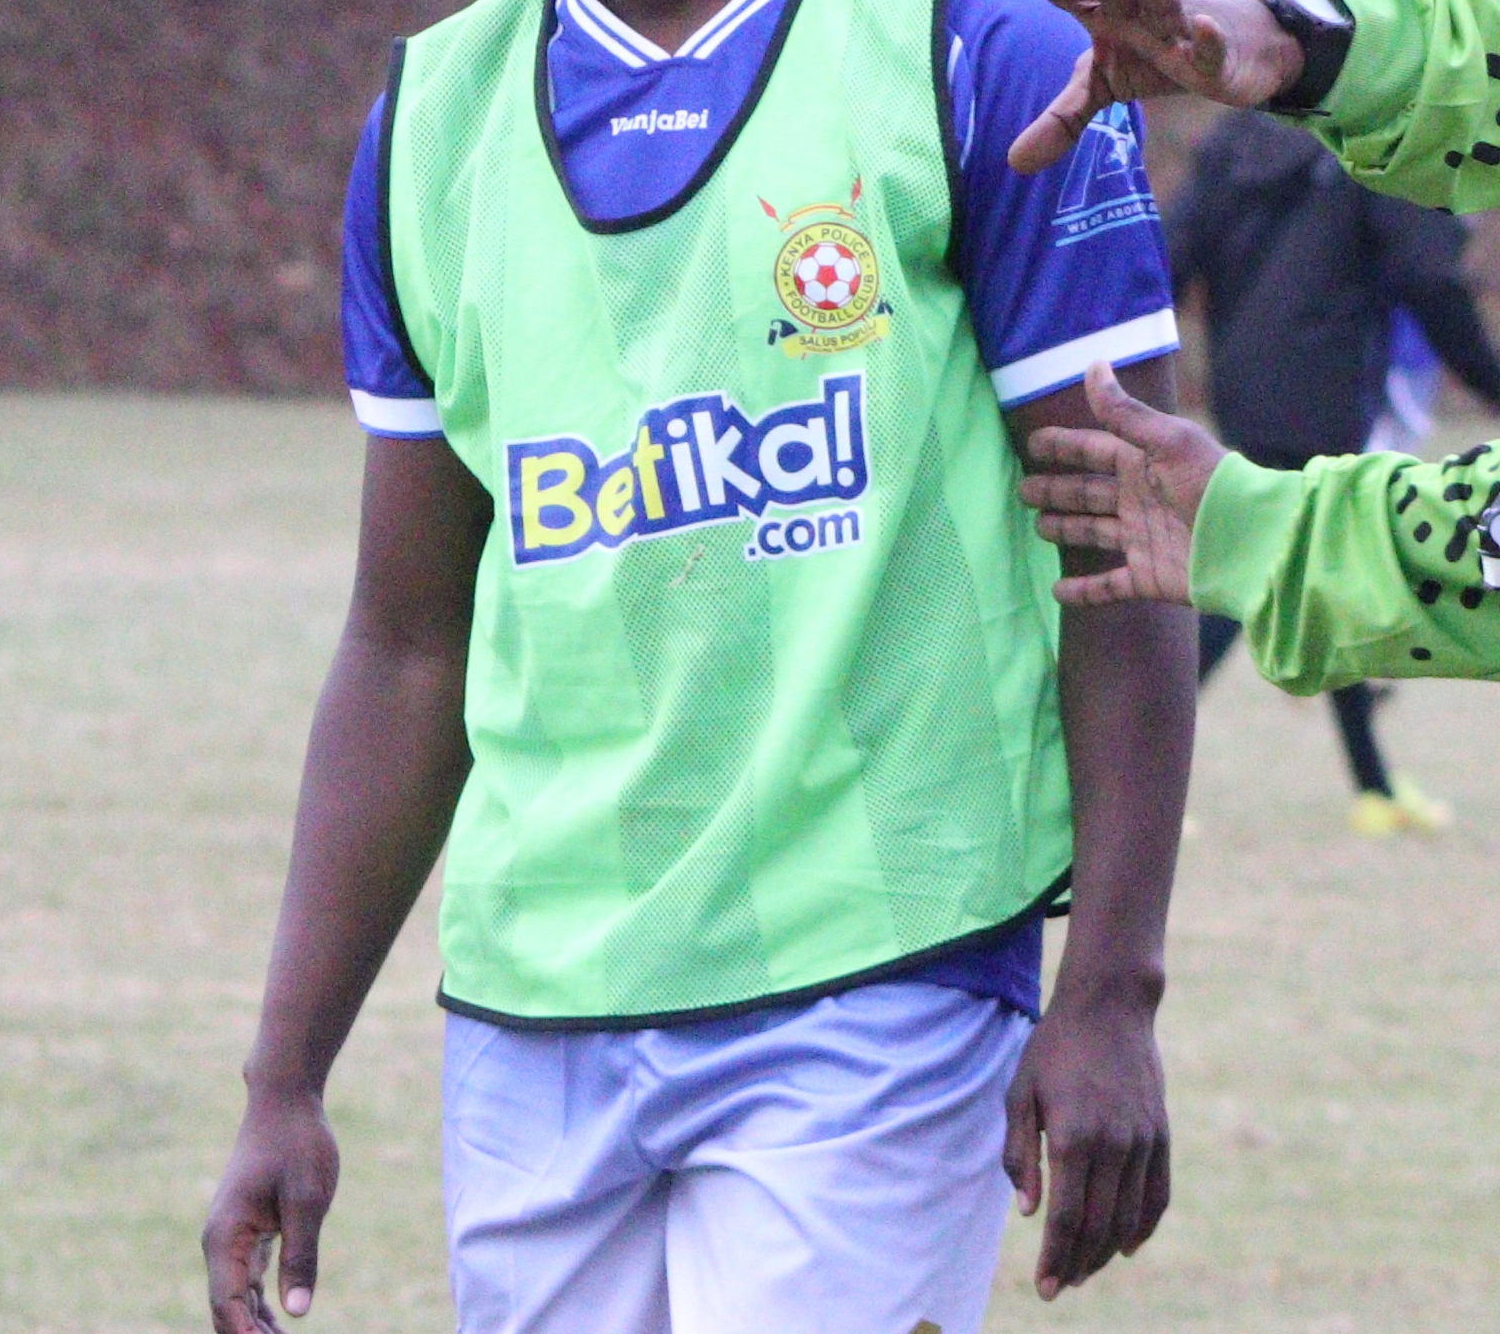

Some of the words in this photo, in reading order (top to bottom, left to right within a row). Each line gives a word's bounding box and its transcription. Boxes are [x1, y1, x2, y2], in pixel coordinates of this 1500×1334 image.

[780, 233, 814, 277] KENYA
[821, 228, 870, 259] POLICE
[786, 290, 855, 324] FOOTBALL
[852, 274, 875, 310] CLUB
[799, 334, 838, 347] SALUS
[518, 388, 858, 550] Betika!
[748, 510, 860, 556] .com
